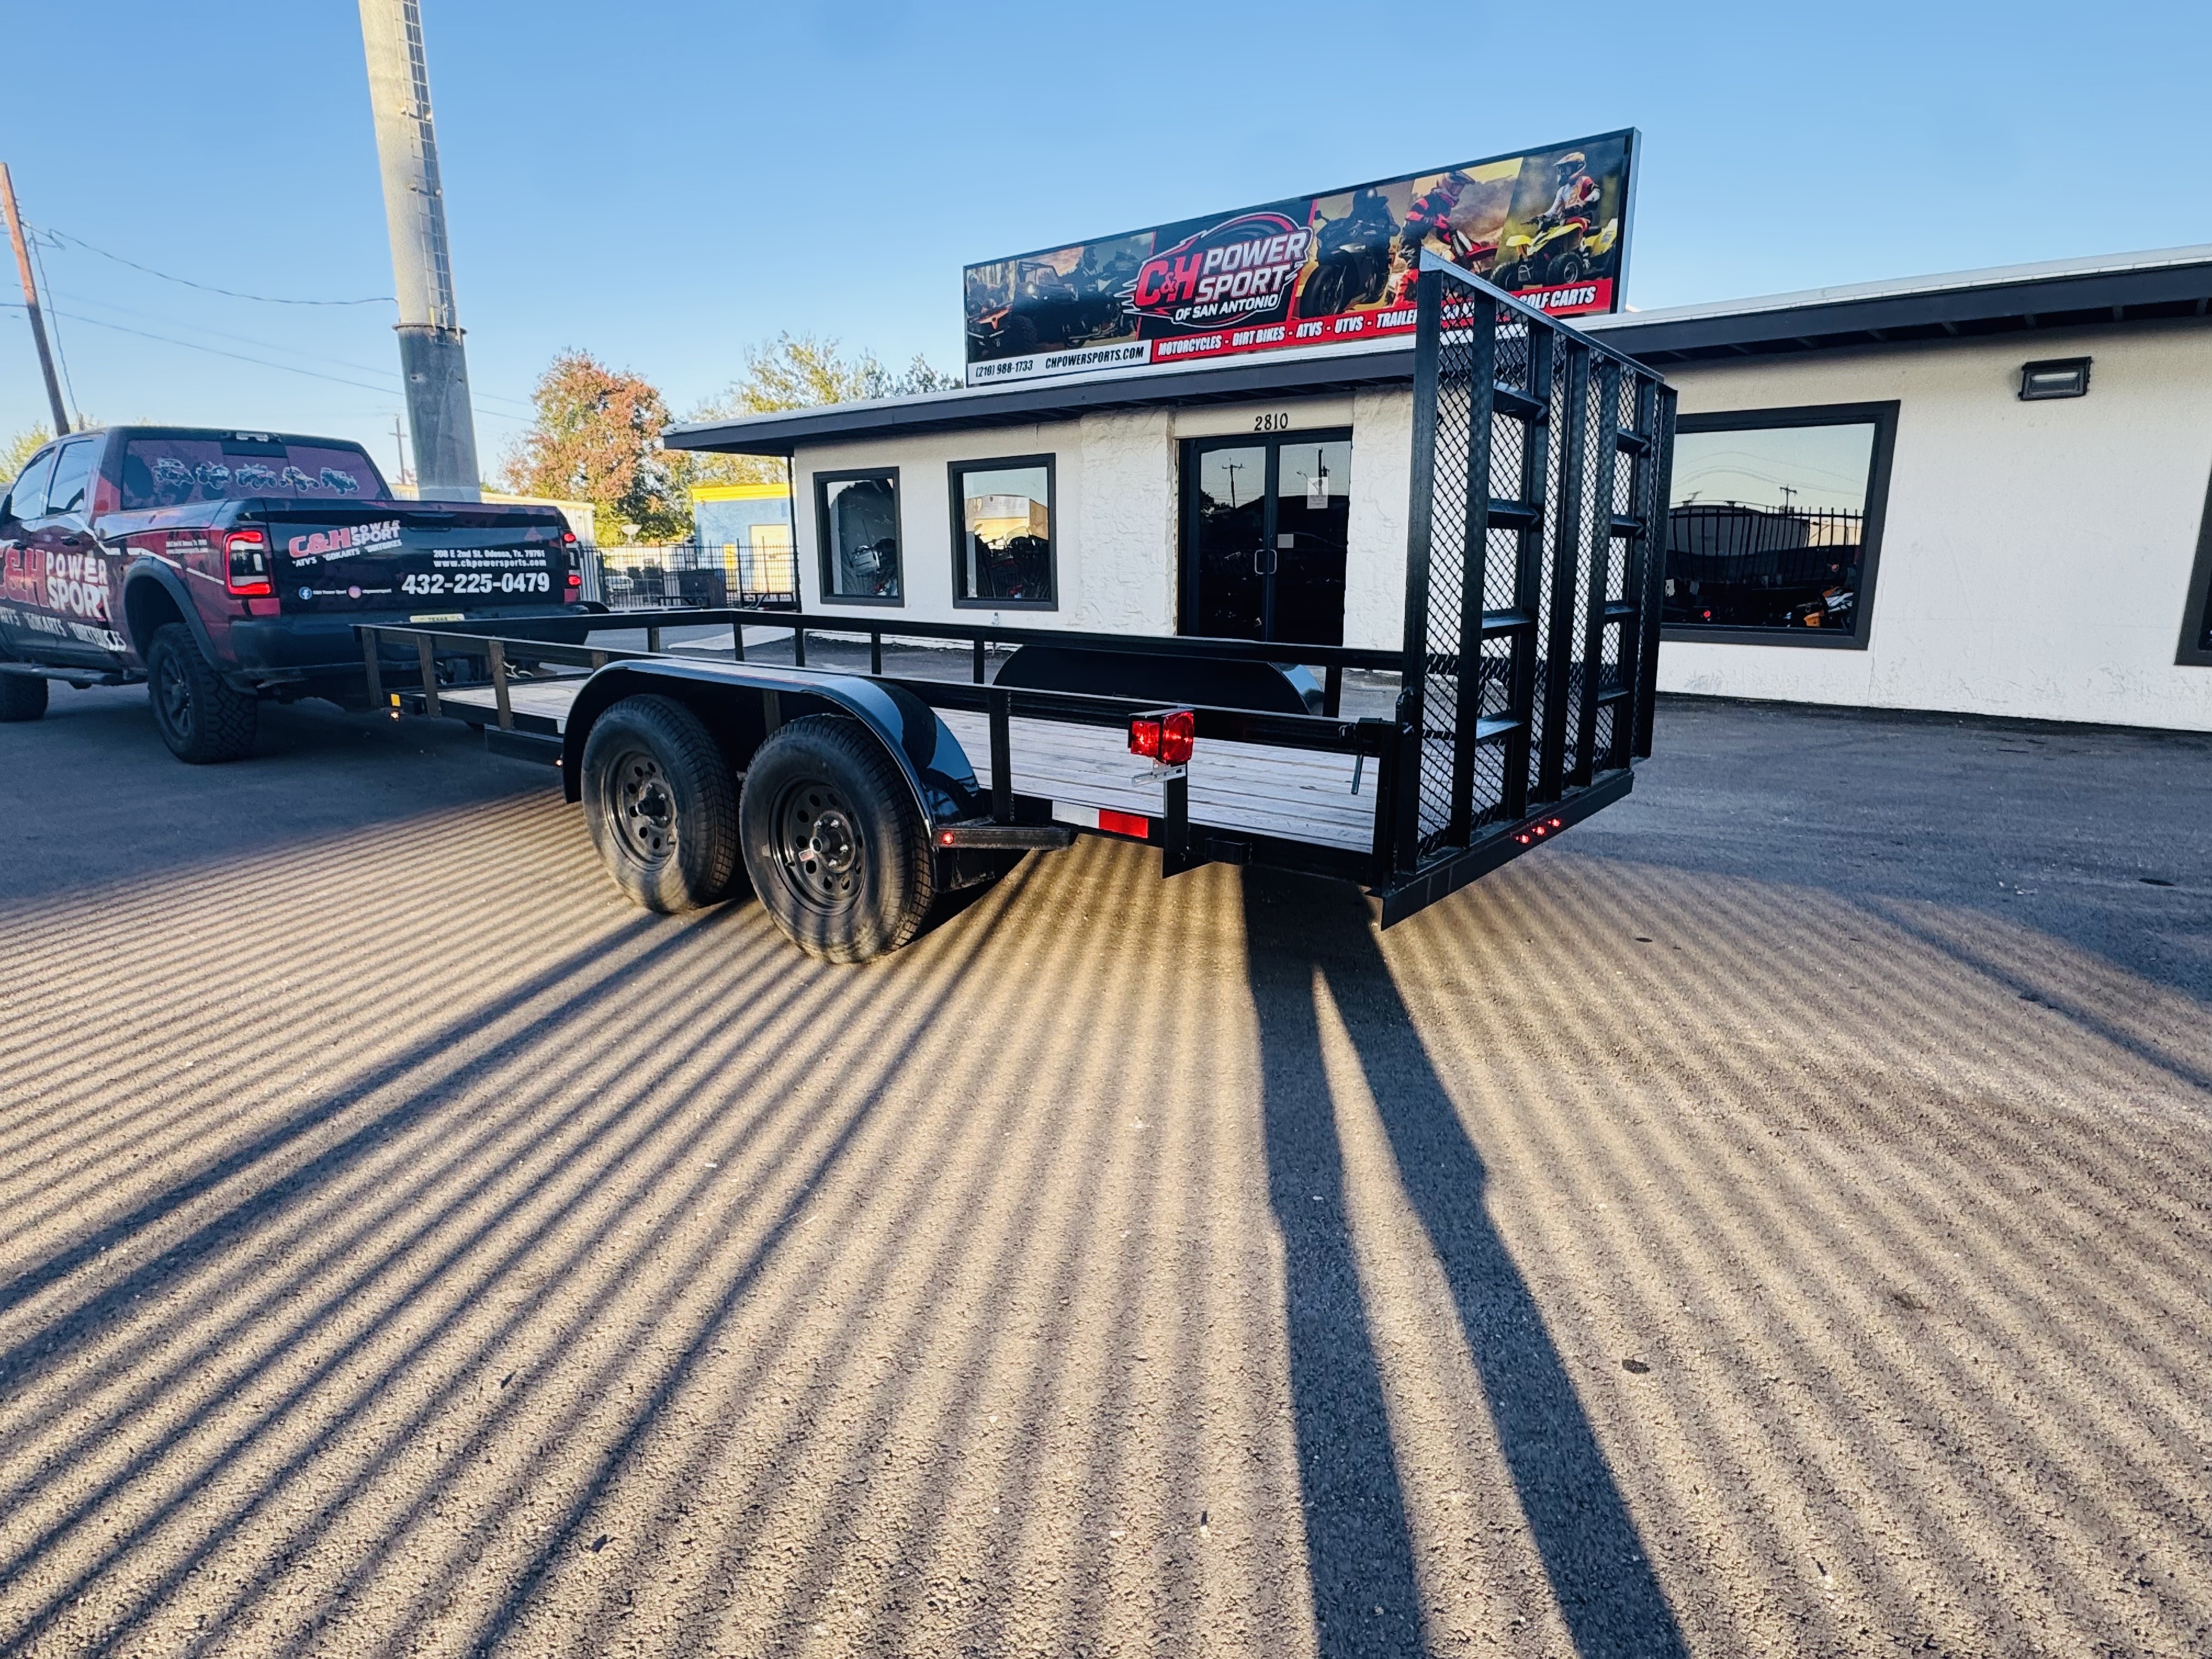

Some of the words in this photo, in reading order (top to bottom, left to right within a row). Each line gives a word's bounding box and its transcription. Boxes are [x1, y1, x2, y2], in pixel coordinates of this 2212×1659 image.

[1135, 252, 1203, 306] C&H
[1202, 232, 1308, 275] POWER
[1195, 264, 1291, 304] SPORT
[1158, 335, 1222, 356] MOTORCYCLES
[1232, 330, 1256, 347] DIRT
[1255, 326, 1286, 343] BIKES
[1295, 321, 1323, 338] ATVS
[1334, 315, 1364, 334] UTVS
[1550, 285, 1596, 308] CARTS
[1175, 307, 1191, 321] OF
[1192, 303, 1218, 318] SAN
[1219, 294, 1279, 315] ANTONIO
[996, 360, 1034, 375] 988-1733
[1045, 346, 1144, 369] CHPOWERSPORTS.COM
[1254, 413, 1288, 431] 2810
[289, 527, 352, 558] C&H
[350, 520, 401, 535] POWER
[351, 527, 400, 547] SPORT
[433, 558, 547, 569] www.chpowersports.com
[449, 550, 456, 558] E
[456, 550, 472, 558] 2nd
[0, 546, 50, 610] &H
[46, 551, 108, 585] POWER
[401, 572, 550, 595] 432-225-0479
[47, 576, 114, 624] SPORT
